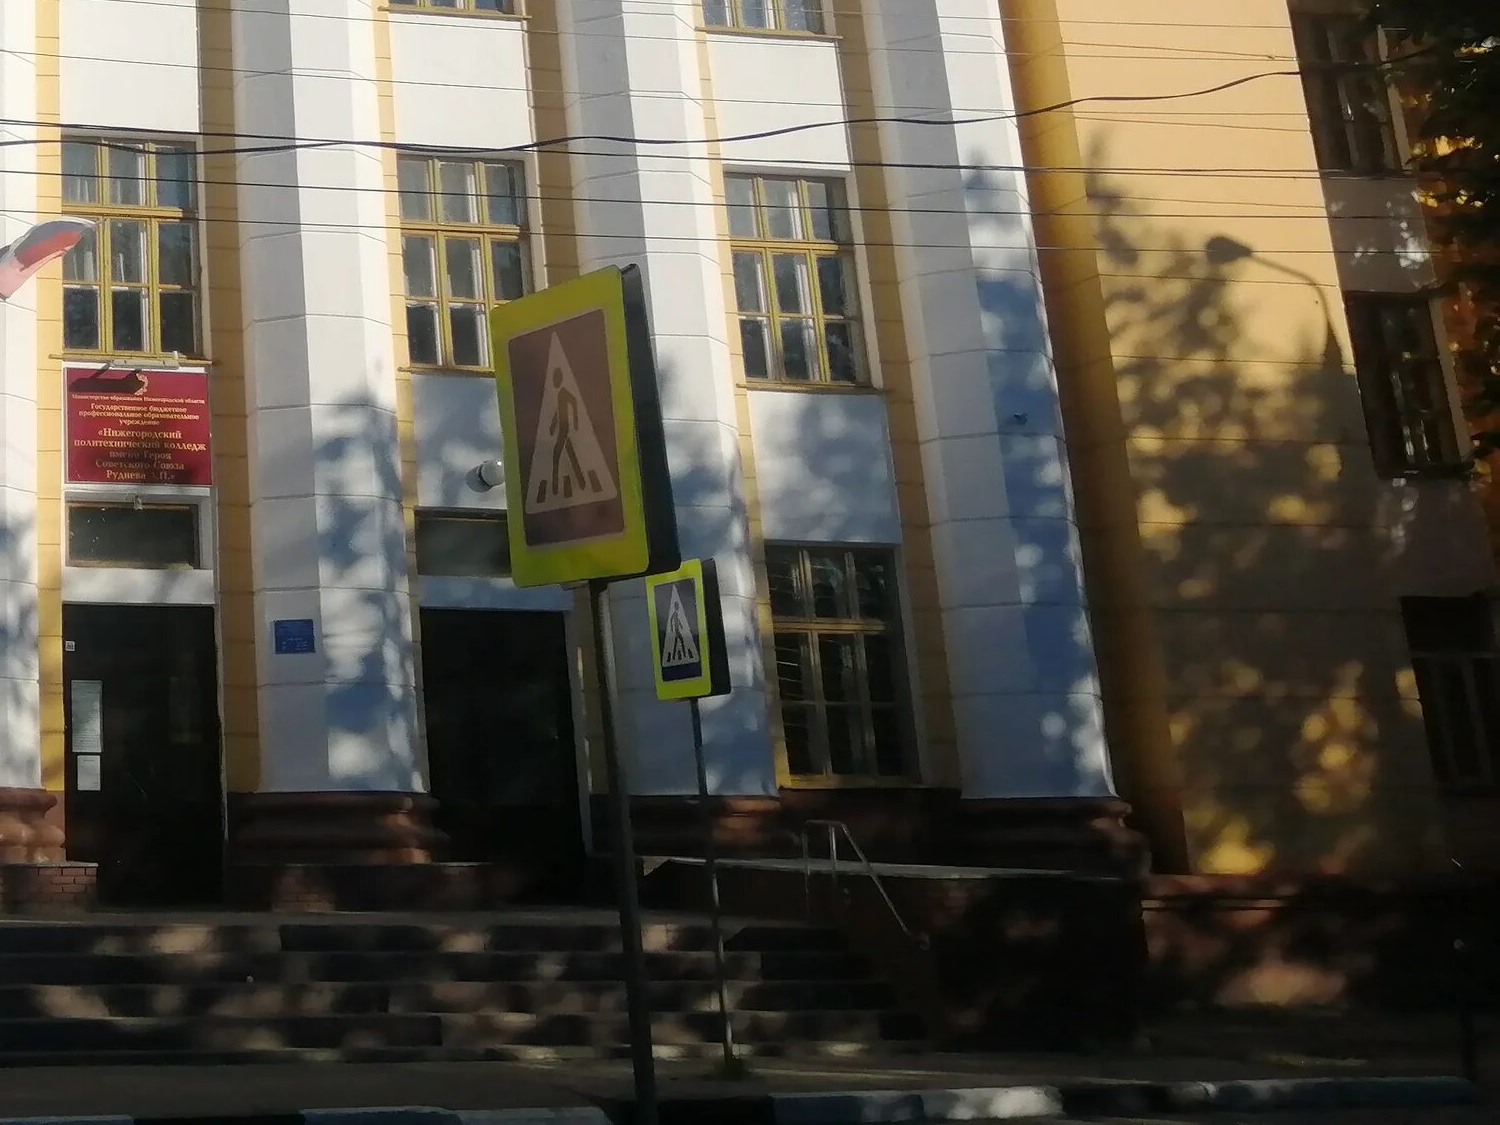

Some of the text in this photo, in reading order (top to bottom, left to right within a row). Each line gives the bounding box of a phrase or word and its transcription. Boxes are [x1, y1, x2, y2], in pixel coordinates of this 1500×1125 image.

[91, 403, 187, 413] Государственное бюджетное
[79, 410, 199, 420] профессиональное образовательное
[119, 419, 160, 427] учреждение
[98, 428, 182, 439] «Нижегородский
[74, 438, 206, 452] политехнический колледж
[110, 451, 171, 461] имени Героя
[96, 459, 184, 470] Советского Союза
[106, 470, 146, 481] Руднева
